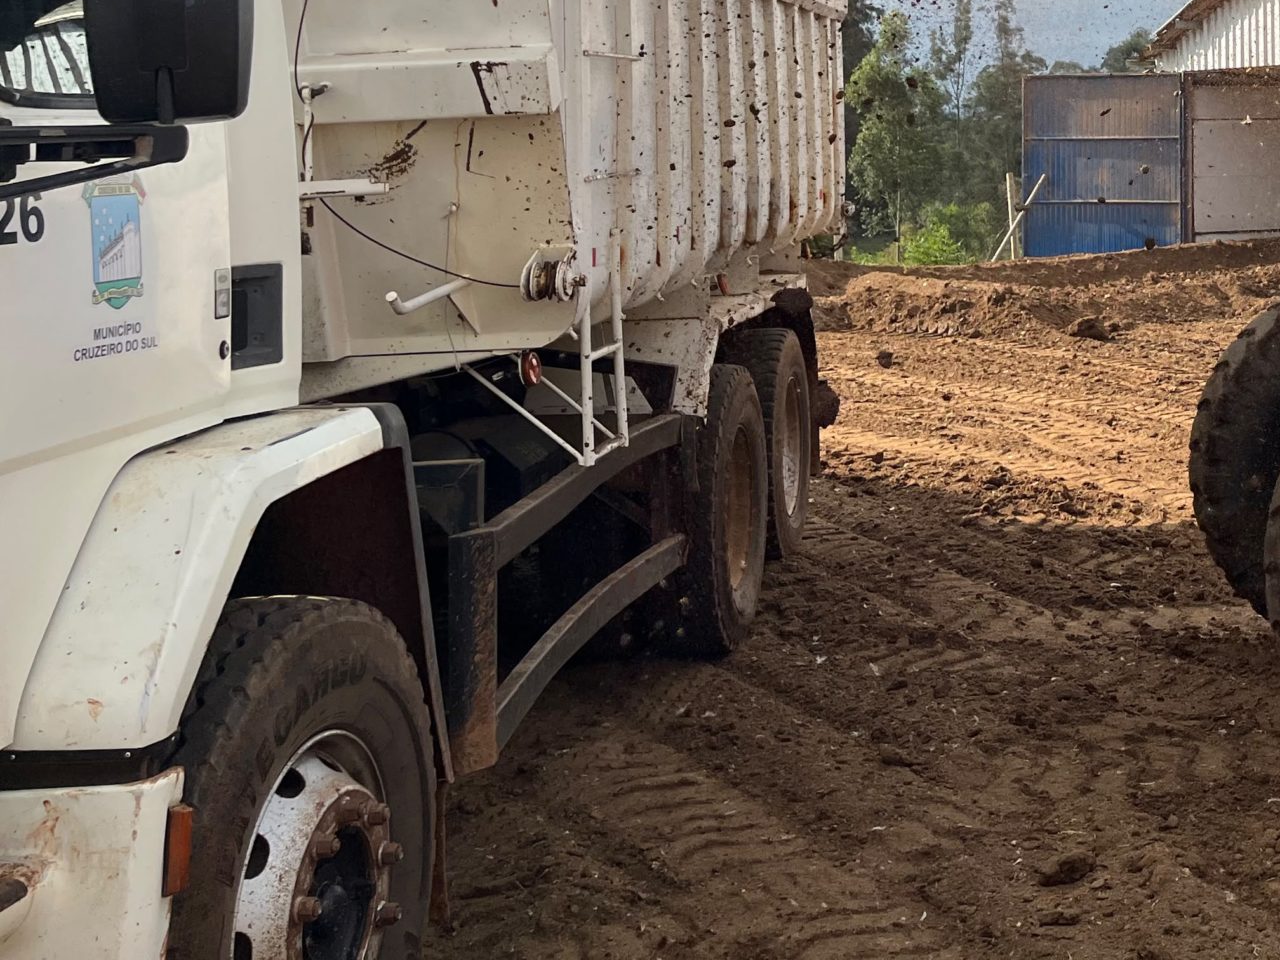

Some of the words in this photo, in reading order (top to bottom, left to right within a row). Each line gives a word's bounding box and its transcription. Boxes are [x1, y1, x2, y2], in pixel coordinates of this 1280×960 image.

[93, 321, 142, 341] MUNICÍPIO
[73, 342, 123, 362] CRUZEIRO
[125, 339, 139, 353] DO
[140, 336, 159, 350] SUL
